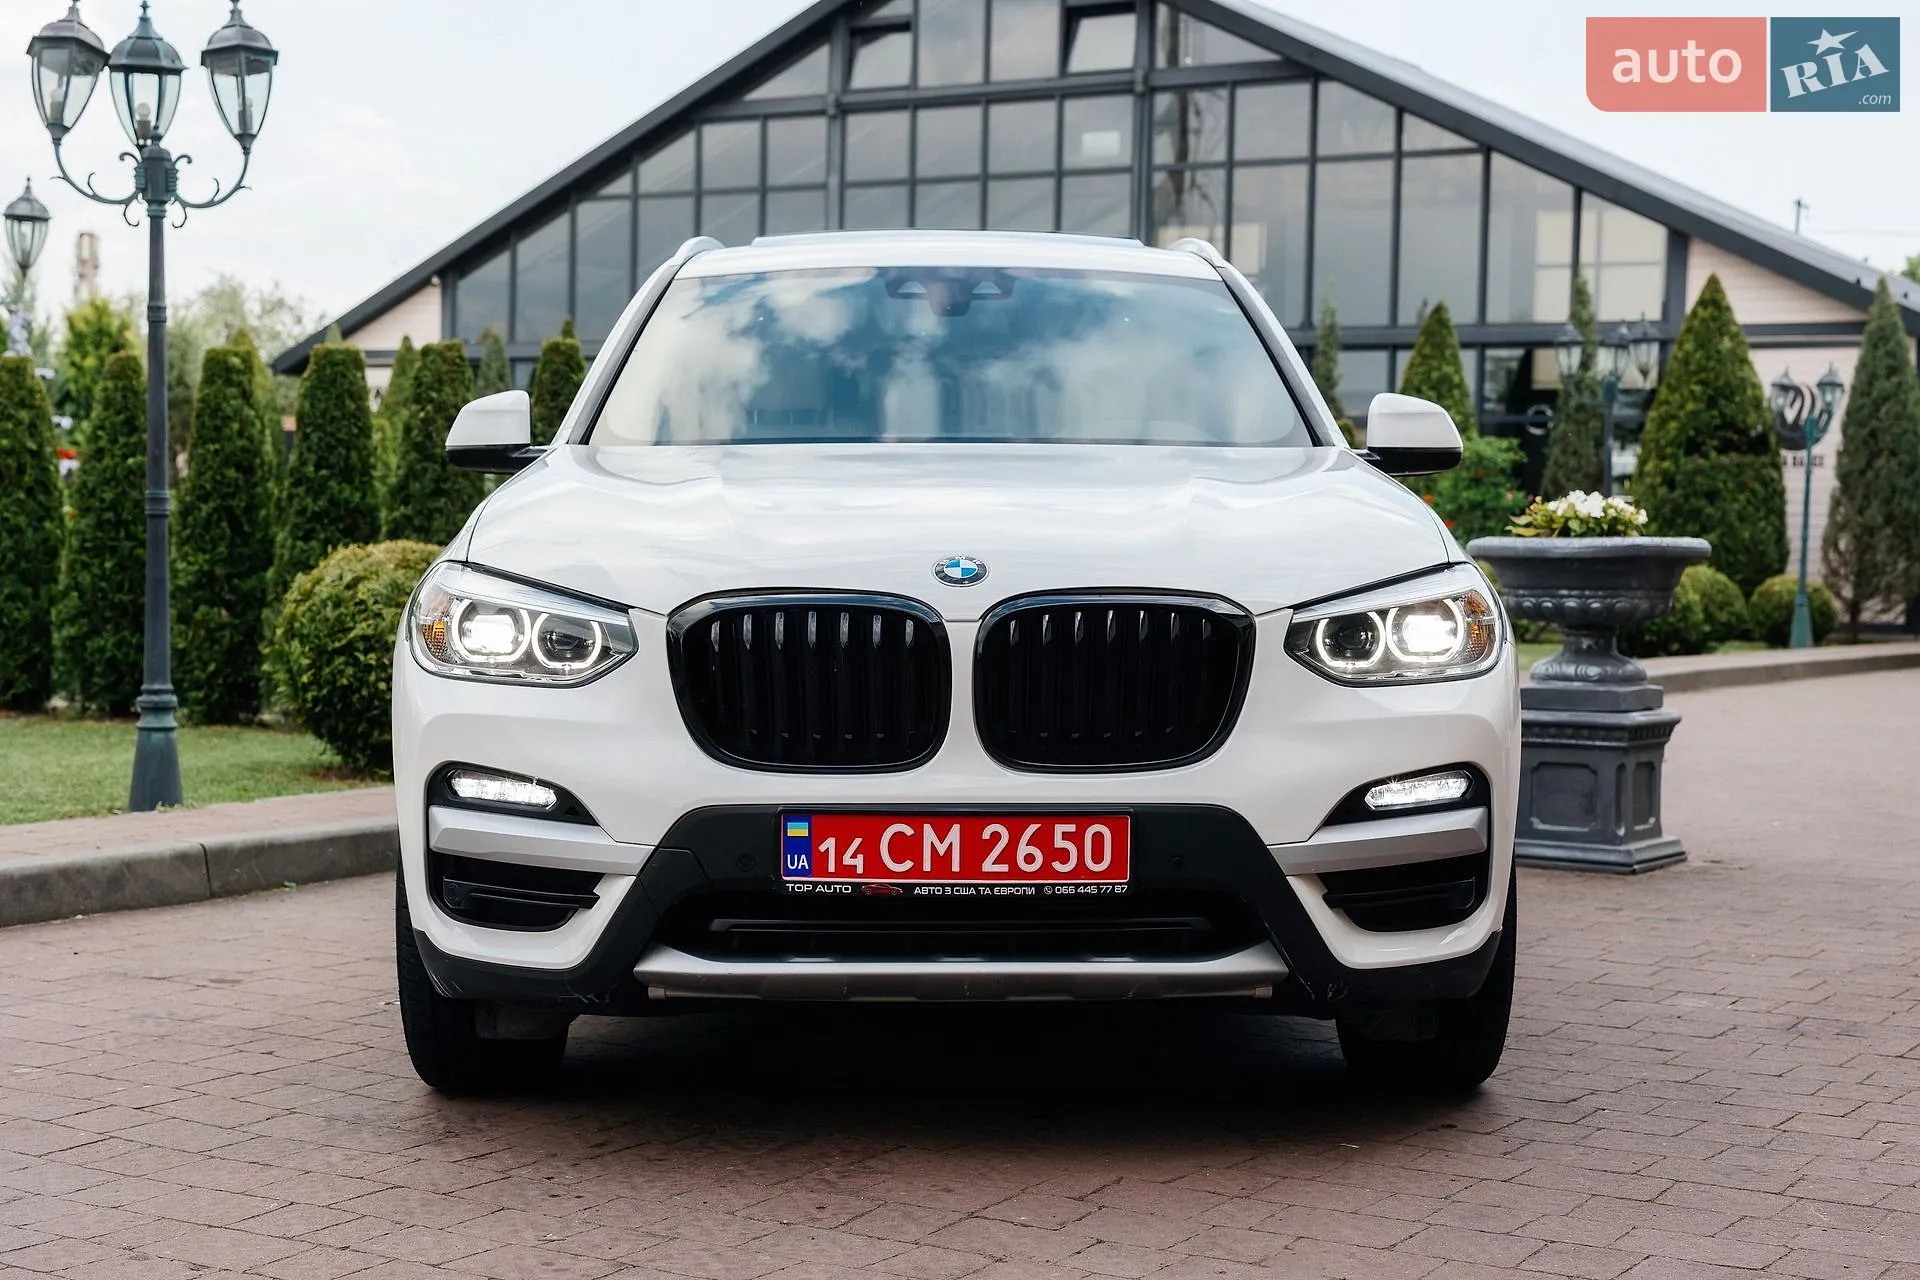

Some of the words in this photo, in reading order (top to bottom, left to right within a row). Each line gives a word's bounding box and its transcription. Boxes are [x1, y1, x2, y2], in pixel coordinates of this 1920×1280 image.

[818, 837, 864, 874] 14
[879, 823, 961, 873] CM
[981, 823, 1112, 873] 2650
[787, 854, 809, 870] UA
[786, 883, 813, 893] TOP
[815, 884, 852, 893] AUTO
[913, 886, 942, 895] АВТО
[953, 886, 977, 895] США
[978, 886, 992, 895] ТА
[993, 886, 1036, 895] ЄВРОПИ
[1054, 885, 1076, 895] 066
[1077, 885, 1098, 894] 445
[1099, 885, 1113, 894] 77
[1114, 884, 1128, 893] 87
